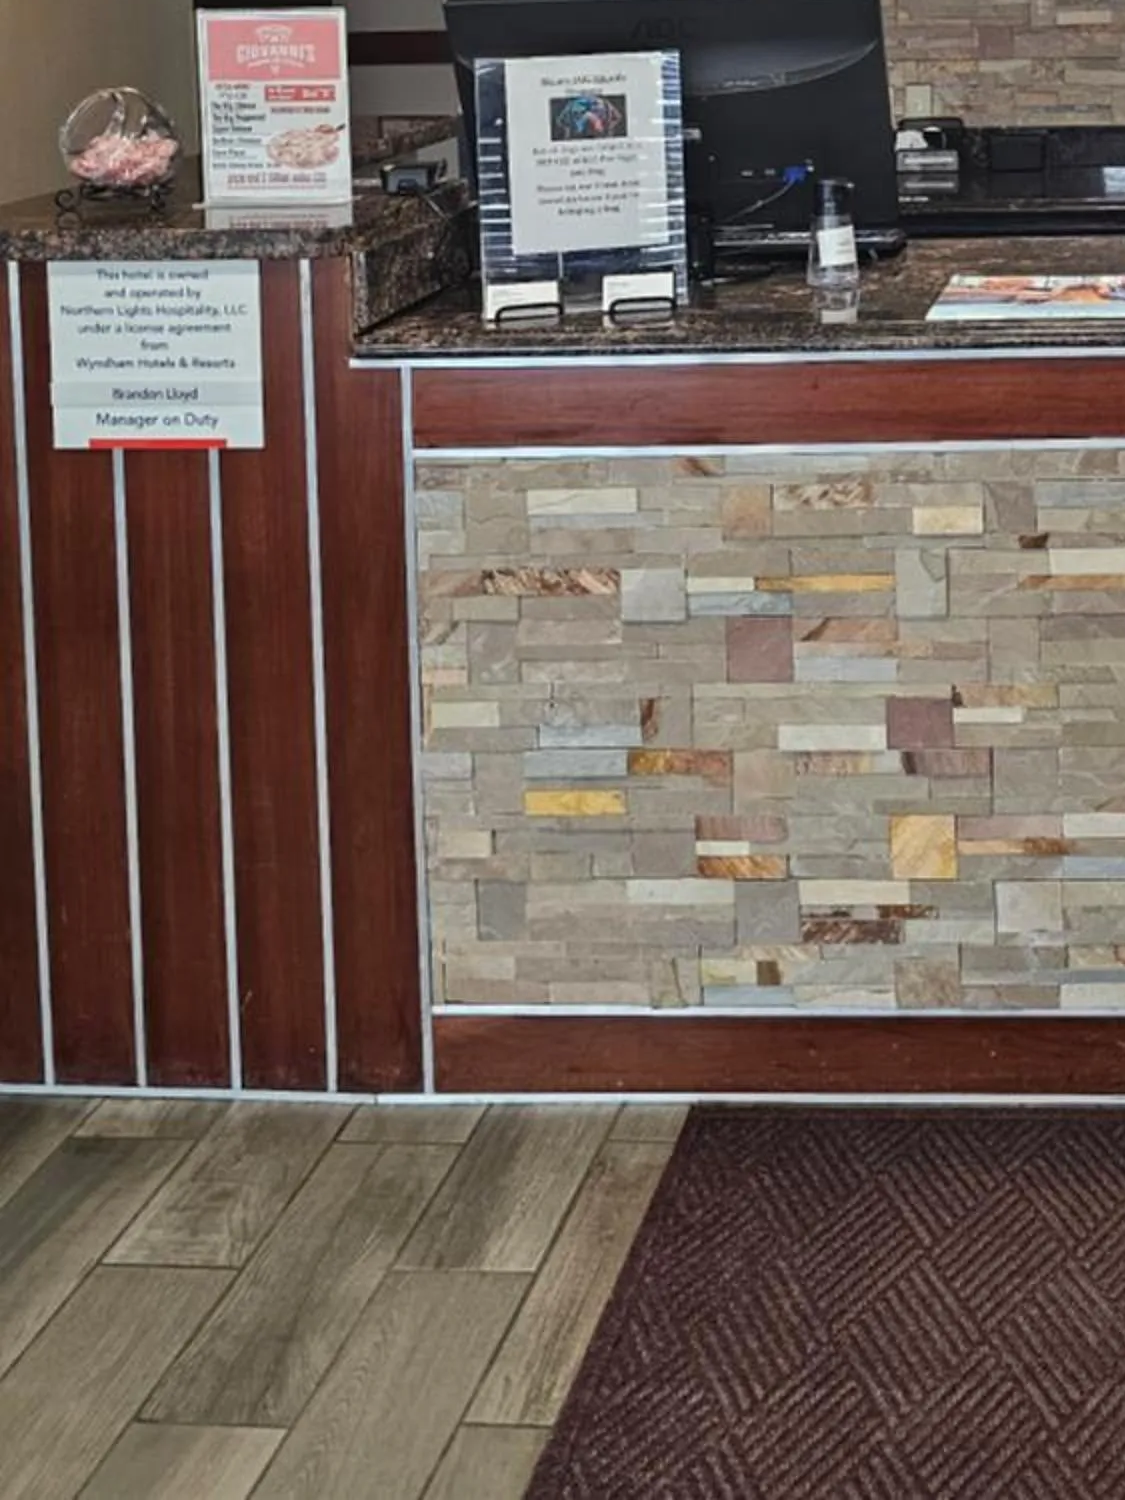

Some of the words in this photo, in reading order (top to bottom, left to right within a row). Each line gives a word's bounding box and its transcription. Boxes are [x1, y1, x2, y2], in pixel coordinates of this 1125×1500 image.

[96, 269, 119, 280] This
[122, 269, 152, 280] hotel
[157, 269, 166, 280] is
[168, 269, 209, 280] owned
[104, 288, 126, 298] and
[130, 287, 184, 300] operated
[186, 287, 201, 299] by
[60, 305, 114, 316] Northern
[117, 304, 151, 318] Lights
[223, 304, 249, 316] LLC
[77, 323, 112, 334] under
[124, 323, 164, 334] license
[167, 323, 231, 336] agreement
[140, 339, 169, 350] from
[76, 357, 134, 371] Wyndham
[138, 357, 175, 368] Hotels
[178, 357, 187, 368] &
[191, 356, 235, 368] Resorts
[112, 388, 163, 400] Brandon
[165, 387, 199, 403] Lloyd
[96, 412, 158, 429] Manager
[163, 414, 181, 426] on
[183, 411, 219, 430] Duty
